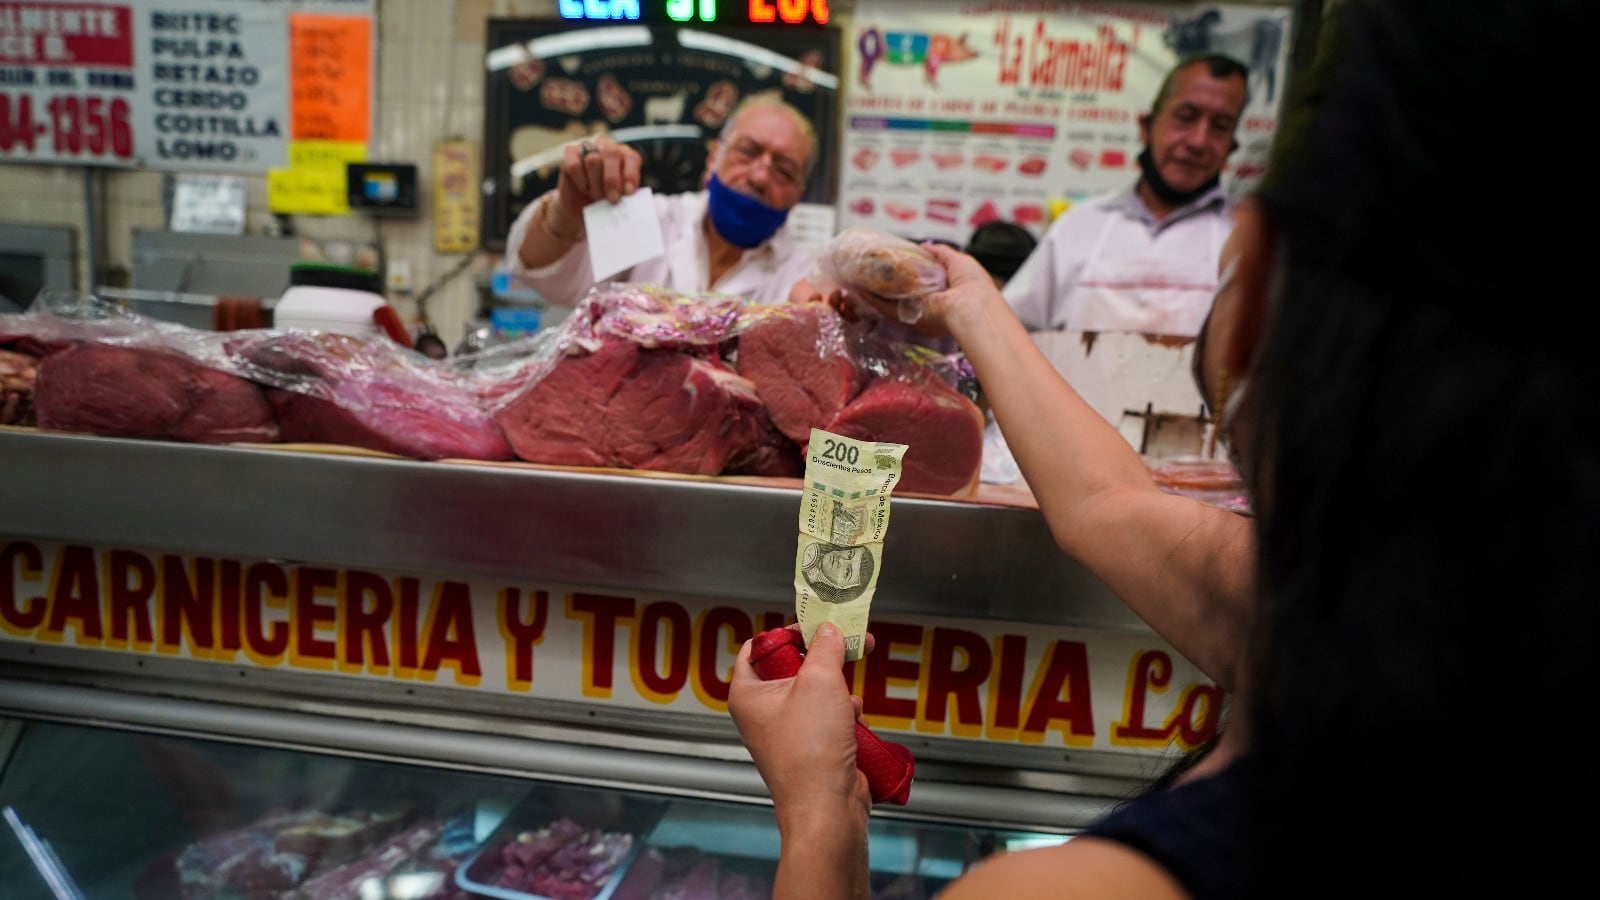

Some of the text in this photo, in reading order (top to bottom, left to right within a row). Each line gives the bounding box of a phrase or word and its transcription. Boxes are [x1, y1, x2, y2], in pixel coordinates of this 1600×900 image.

[152, 12, 241, 34] BISTEC
[152, 37, 244, 60] PULPA
[152, 64, 259, 86] RETAZO
[153, 88, 248, 111] CERDO
[154, 113, 281, 137] COSTILLA
[156, 139, 238, 161] LOMO
[822, 439, 859, 465] 200
[812, 456, 872, 475] Doscientos Pesos
[880, 473, 896, 494] Banco
[879, 496, 887, 507] de
[0, 540, 482, 687] CARNICERIA
[496, 586, 550, 693] Y
[564, 592, 1096, 748] TOCERIA
